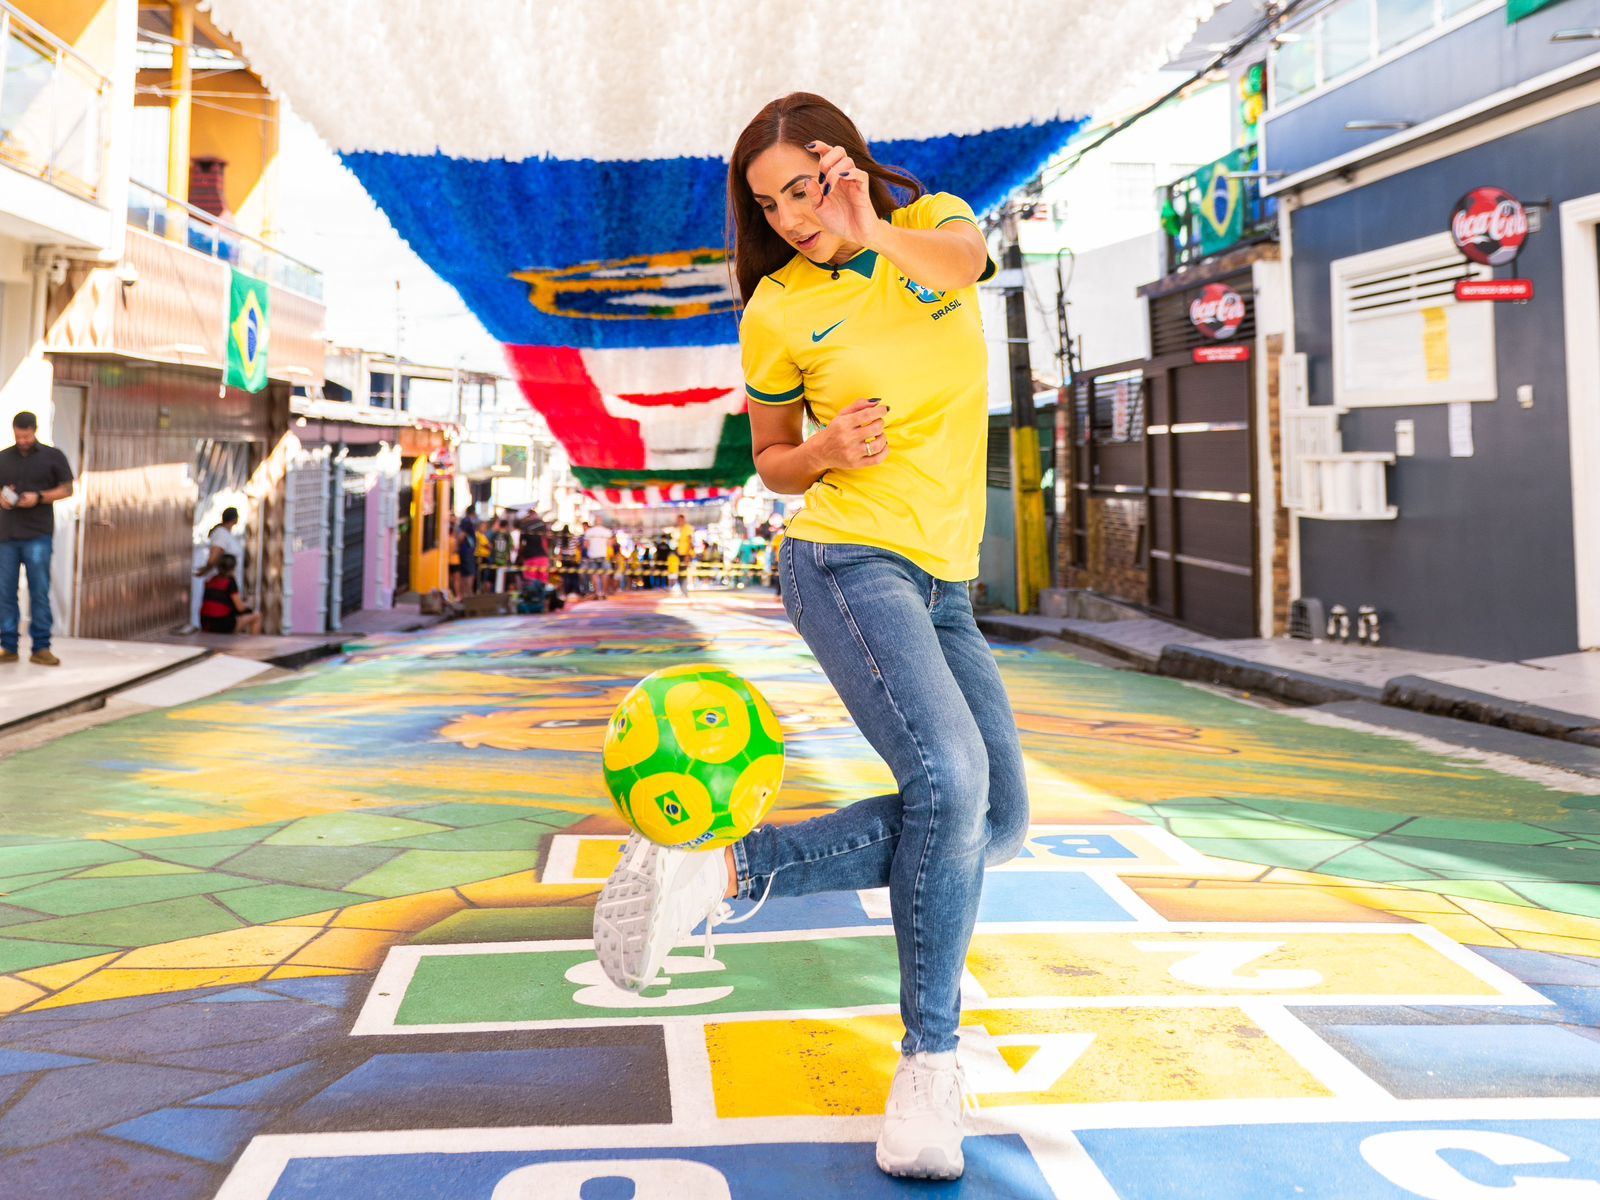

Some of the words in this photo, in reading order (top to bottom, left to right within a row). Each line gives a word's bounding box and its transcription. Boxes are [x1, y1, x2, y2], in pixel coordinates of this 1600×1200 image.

[1452, 199, 1528, 247] Coca-Cola
[930, 299, 962, 321] BRASIL
[1190, 292, 1246, 326] Coca-Cola
[564, 955, 735, 1009] 3
[1131, 940, 1323, 989] 2
